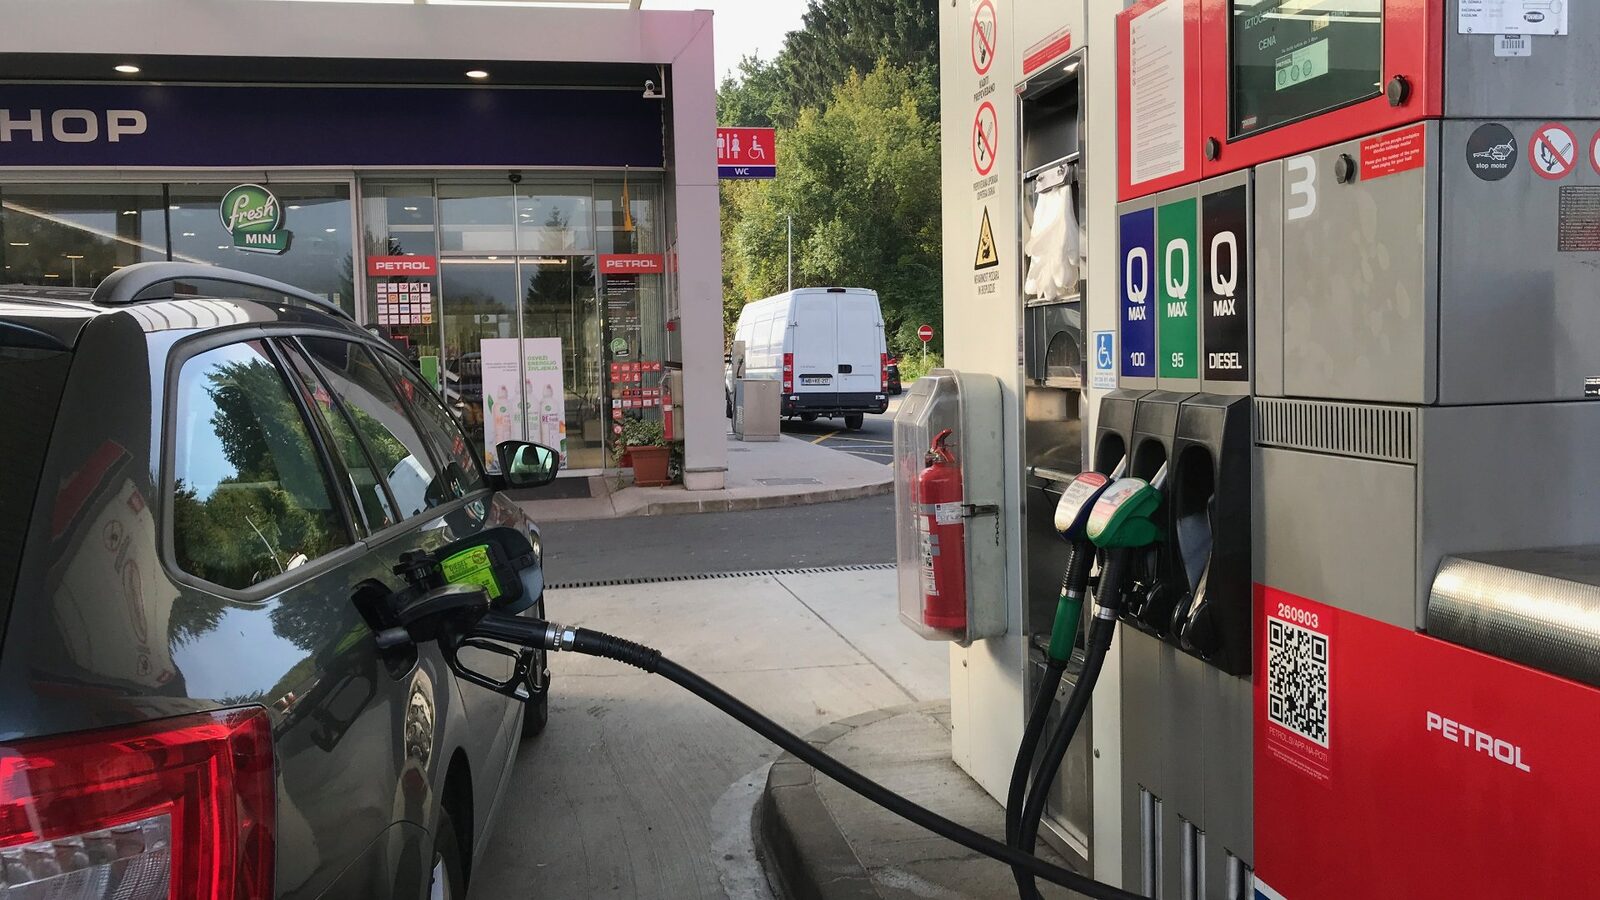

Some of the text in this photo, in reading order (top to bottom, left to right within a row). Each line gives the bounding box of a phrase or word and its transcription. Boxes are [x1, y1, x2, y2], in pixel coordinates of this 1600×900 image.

[1258, 35, 1277, 51] CENA
[0, 109, 147, 143] HOP
[734, 167, 750, 176] WC
[1476, 162, 1489, 170] stop
[1287, 155, 1317, 221] 3
[228, 194, 275, 231] fresh
[245, 233, 276, 245] MINI
[375, 261, 431, 270] PETROL
[606, 259, 658, 268] PETROL
[1165, 238, 1190, 300] Q
[1210, 230, 1238, 297] Q
[1126, 246, 1148, 304] Q
[1128, 306, 1146, 321] MAX
[1167, 301, 1188, 318] MAX
[1213, 299, 1236, 317] MAX
[1130, 352, 1146, 367] 100
[1171, 352, 1184, 368] 95
[1208, 352, 1242, 369] DIESEL
[1277, 603, 1319, 629] 260903
[1426, 711, 1531, 773] PETROL
